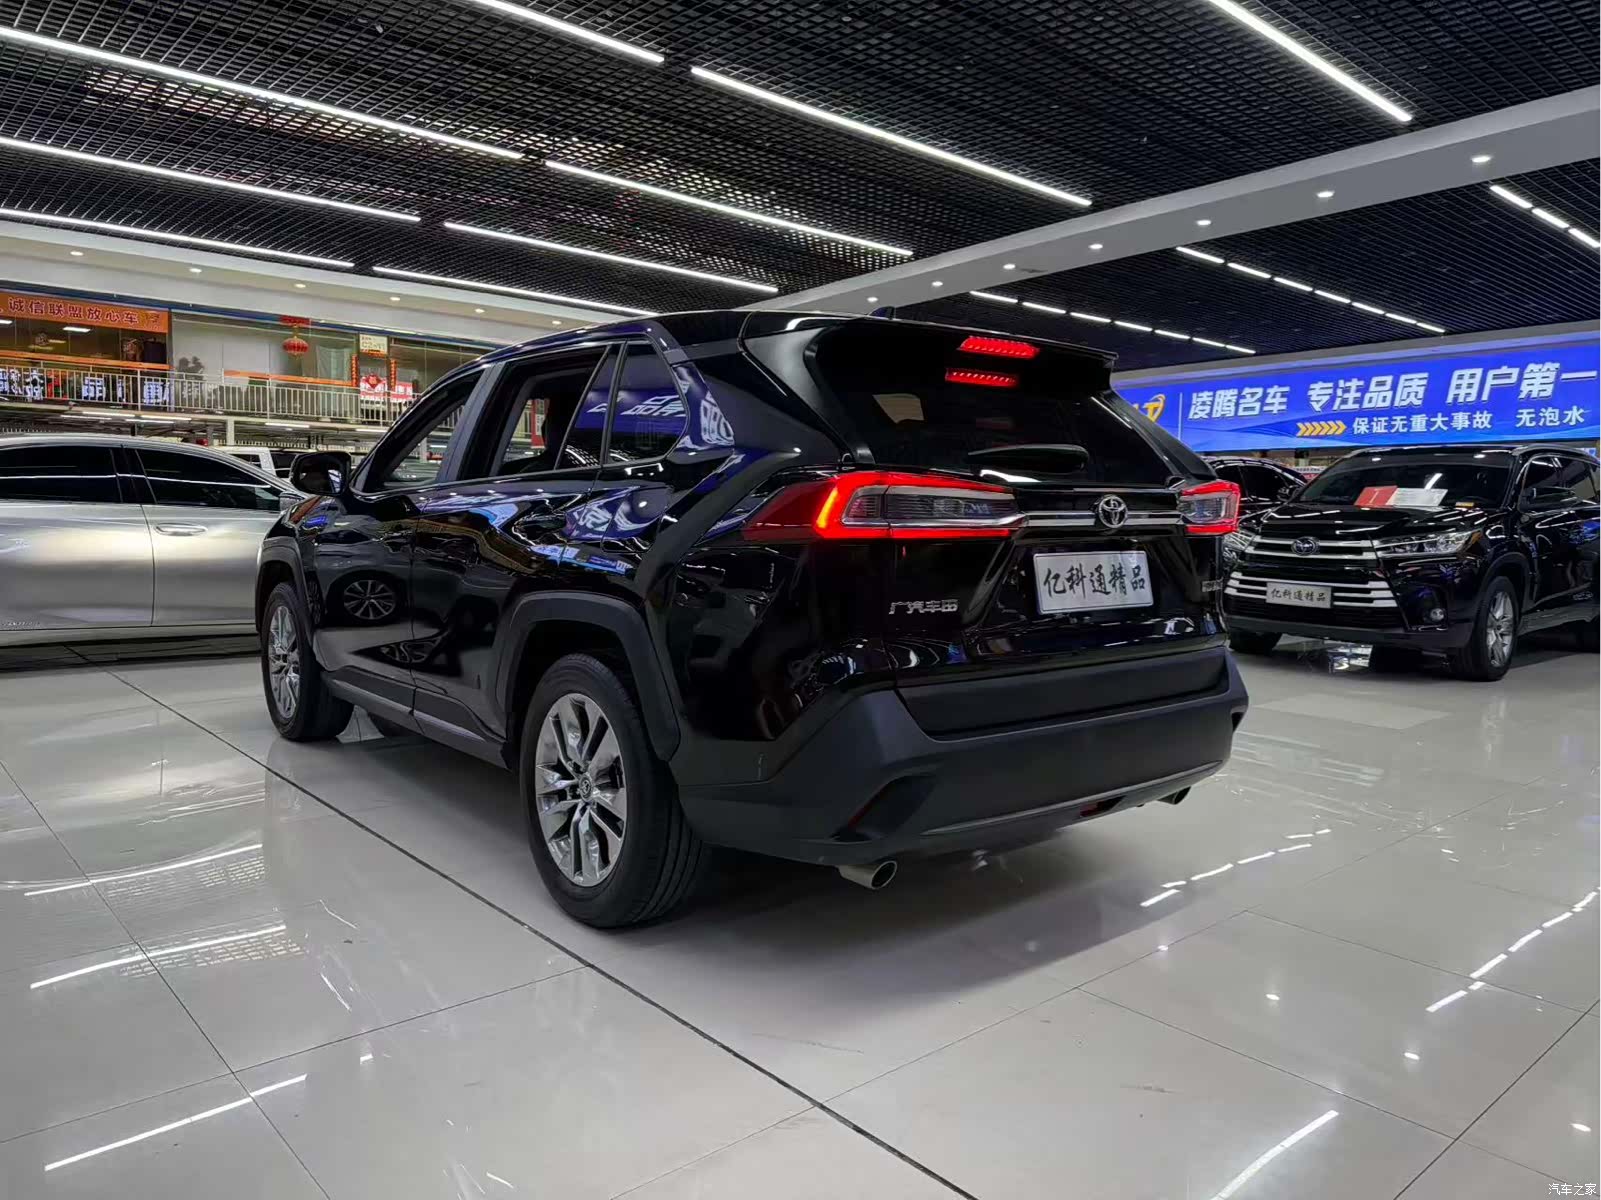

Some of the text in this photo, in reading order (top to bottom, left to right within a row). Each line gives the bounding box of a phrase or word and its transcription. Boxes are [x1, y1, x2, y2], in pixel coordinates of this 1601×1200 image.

[8, 297, 139, 324] 诚信联盟放心车
[1188, 362, 1598, 420] 凌腾名车 专注品质 用户第一
[1352, 405, 1585, 435] 保证无重大事故 无泡水
[1043, 563, 1146, 599] 亿科通精品
